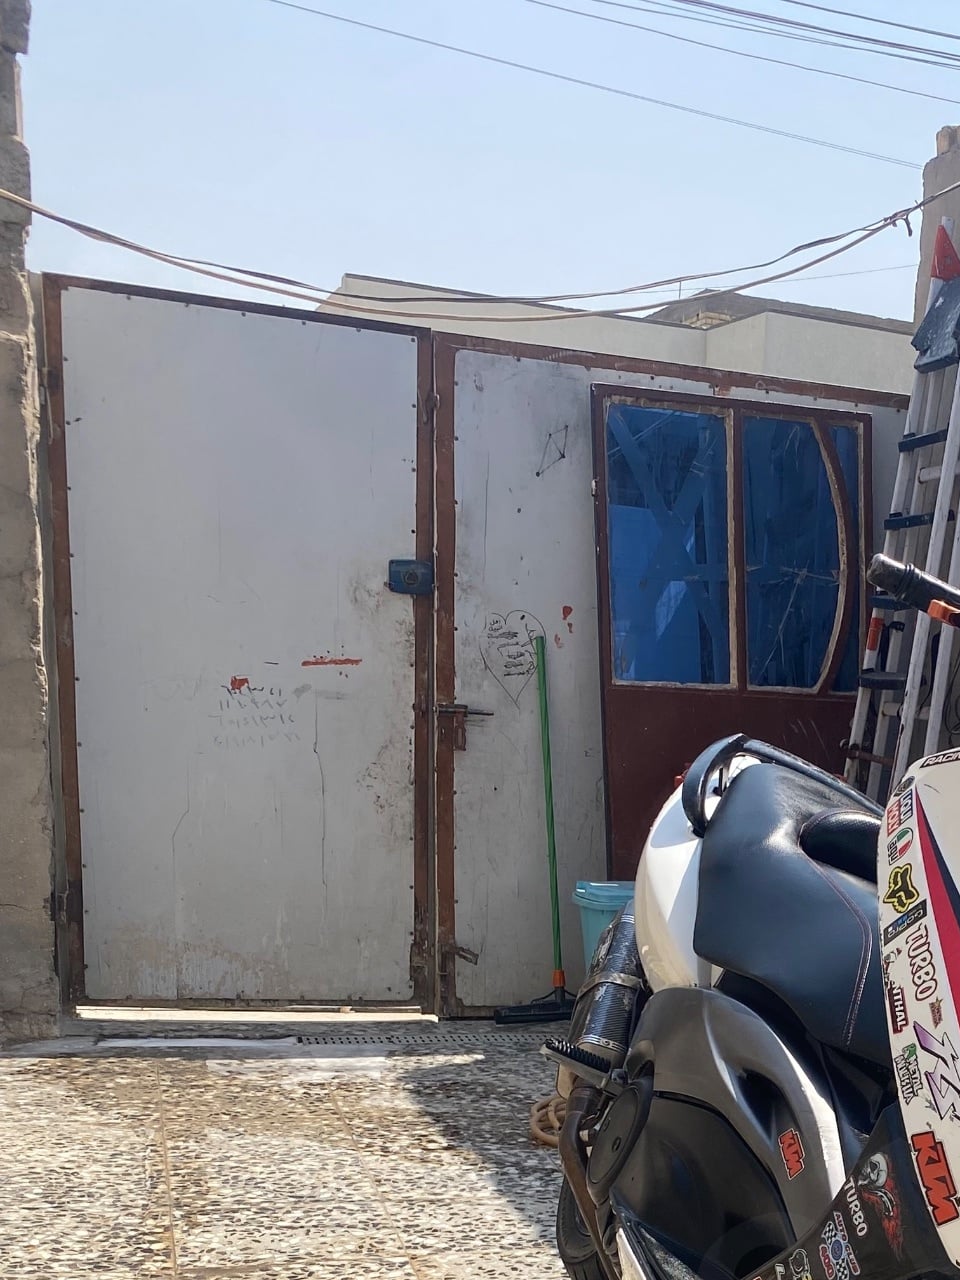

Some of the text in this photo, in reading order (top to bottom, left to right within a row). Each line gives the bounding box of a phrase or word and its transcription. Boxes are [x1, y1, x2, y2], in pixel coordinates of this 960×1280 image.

[905, 922, 938, 1001] TURBO
[908, 1054, 924, 1097] METAL
[779, 1129, 804, 1179] KTM
[911, 1131, 959, 1225] KTM
[843, 1176, 868, 1236] TURBO
